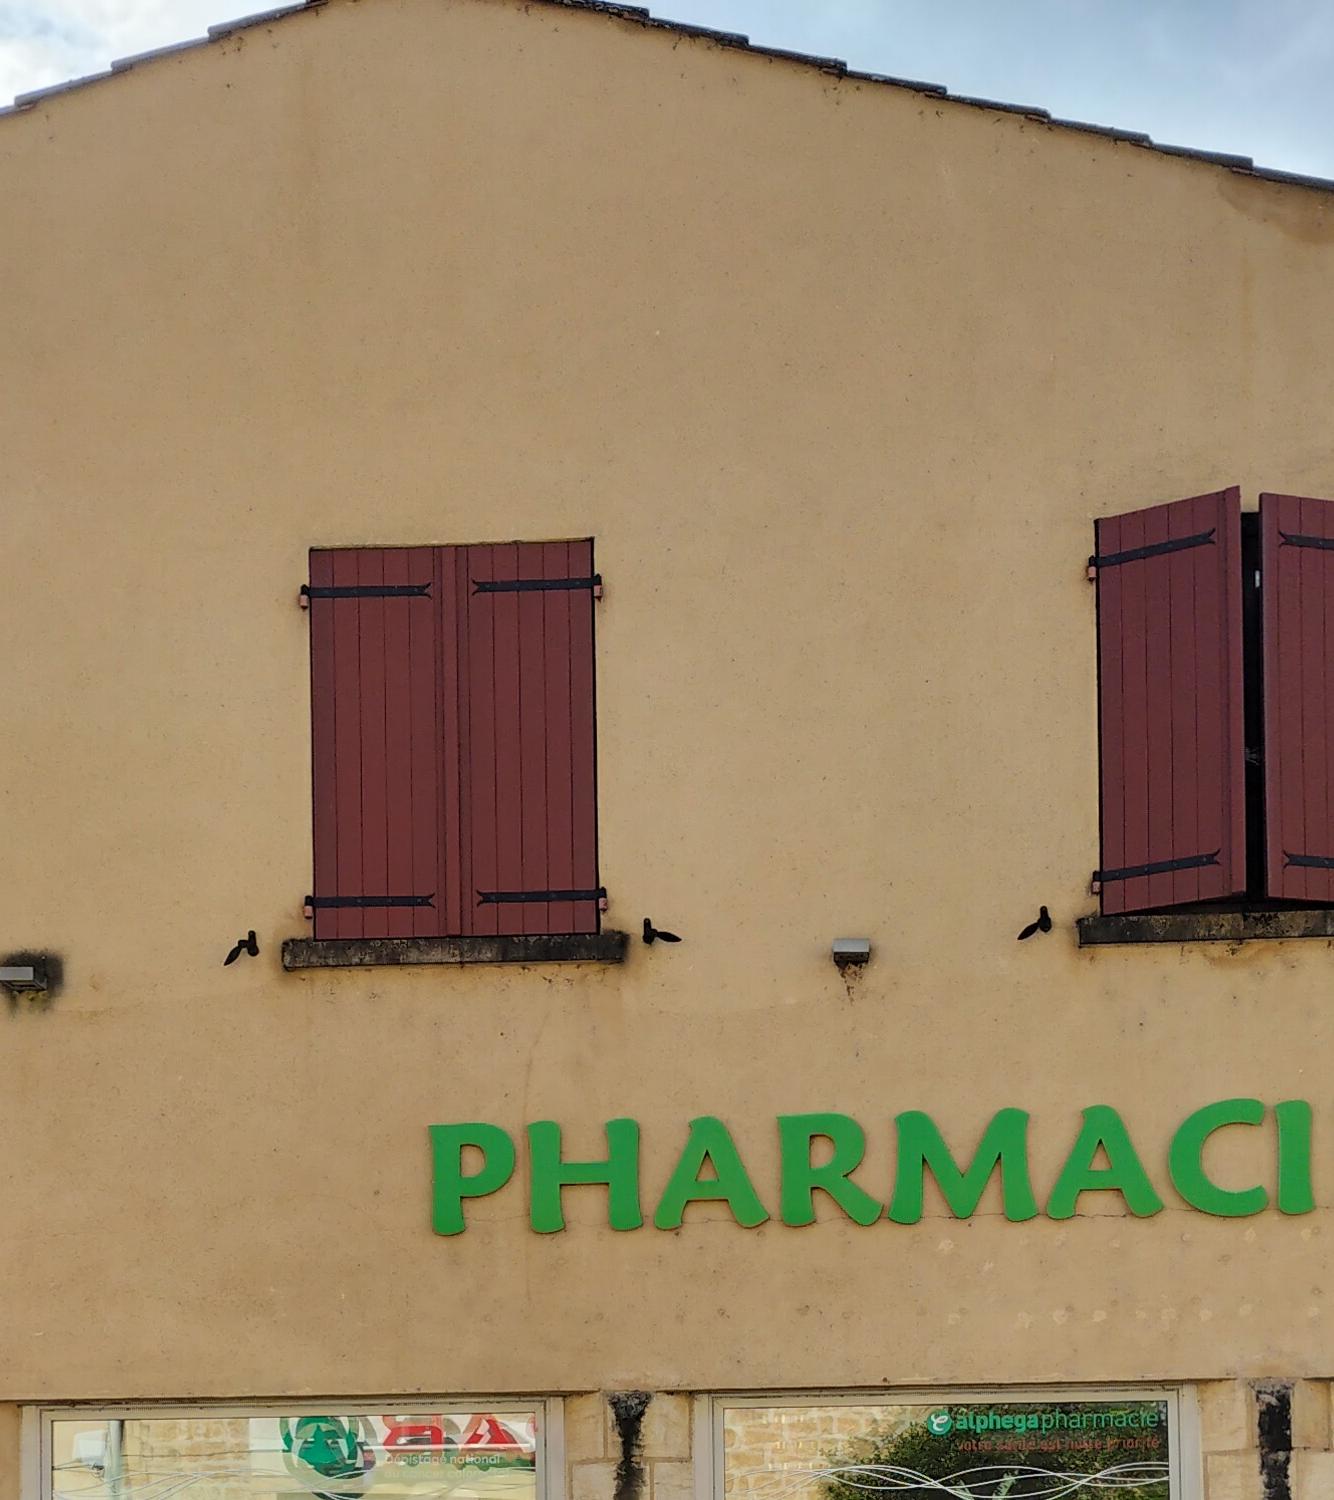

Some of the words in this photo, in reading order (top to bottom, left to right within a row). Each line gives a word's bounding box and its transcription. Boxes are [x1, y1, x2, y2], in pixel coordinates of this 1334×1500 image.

[956, 1411, 1039, 1434] alphega
[1041, 1408, 1159, 1434] pharmacie
[450, 1453, 500, 1464] national
